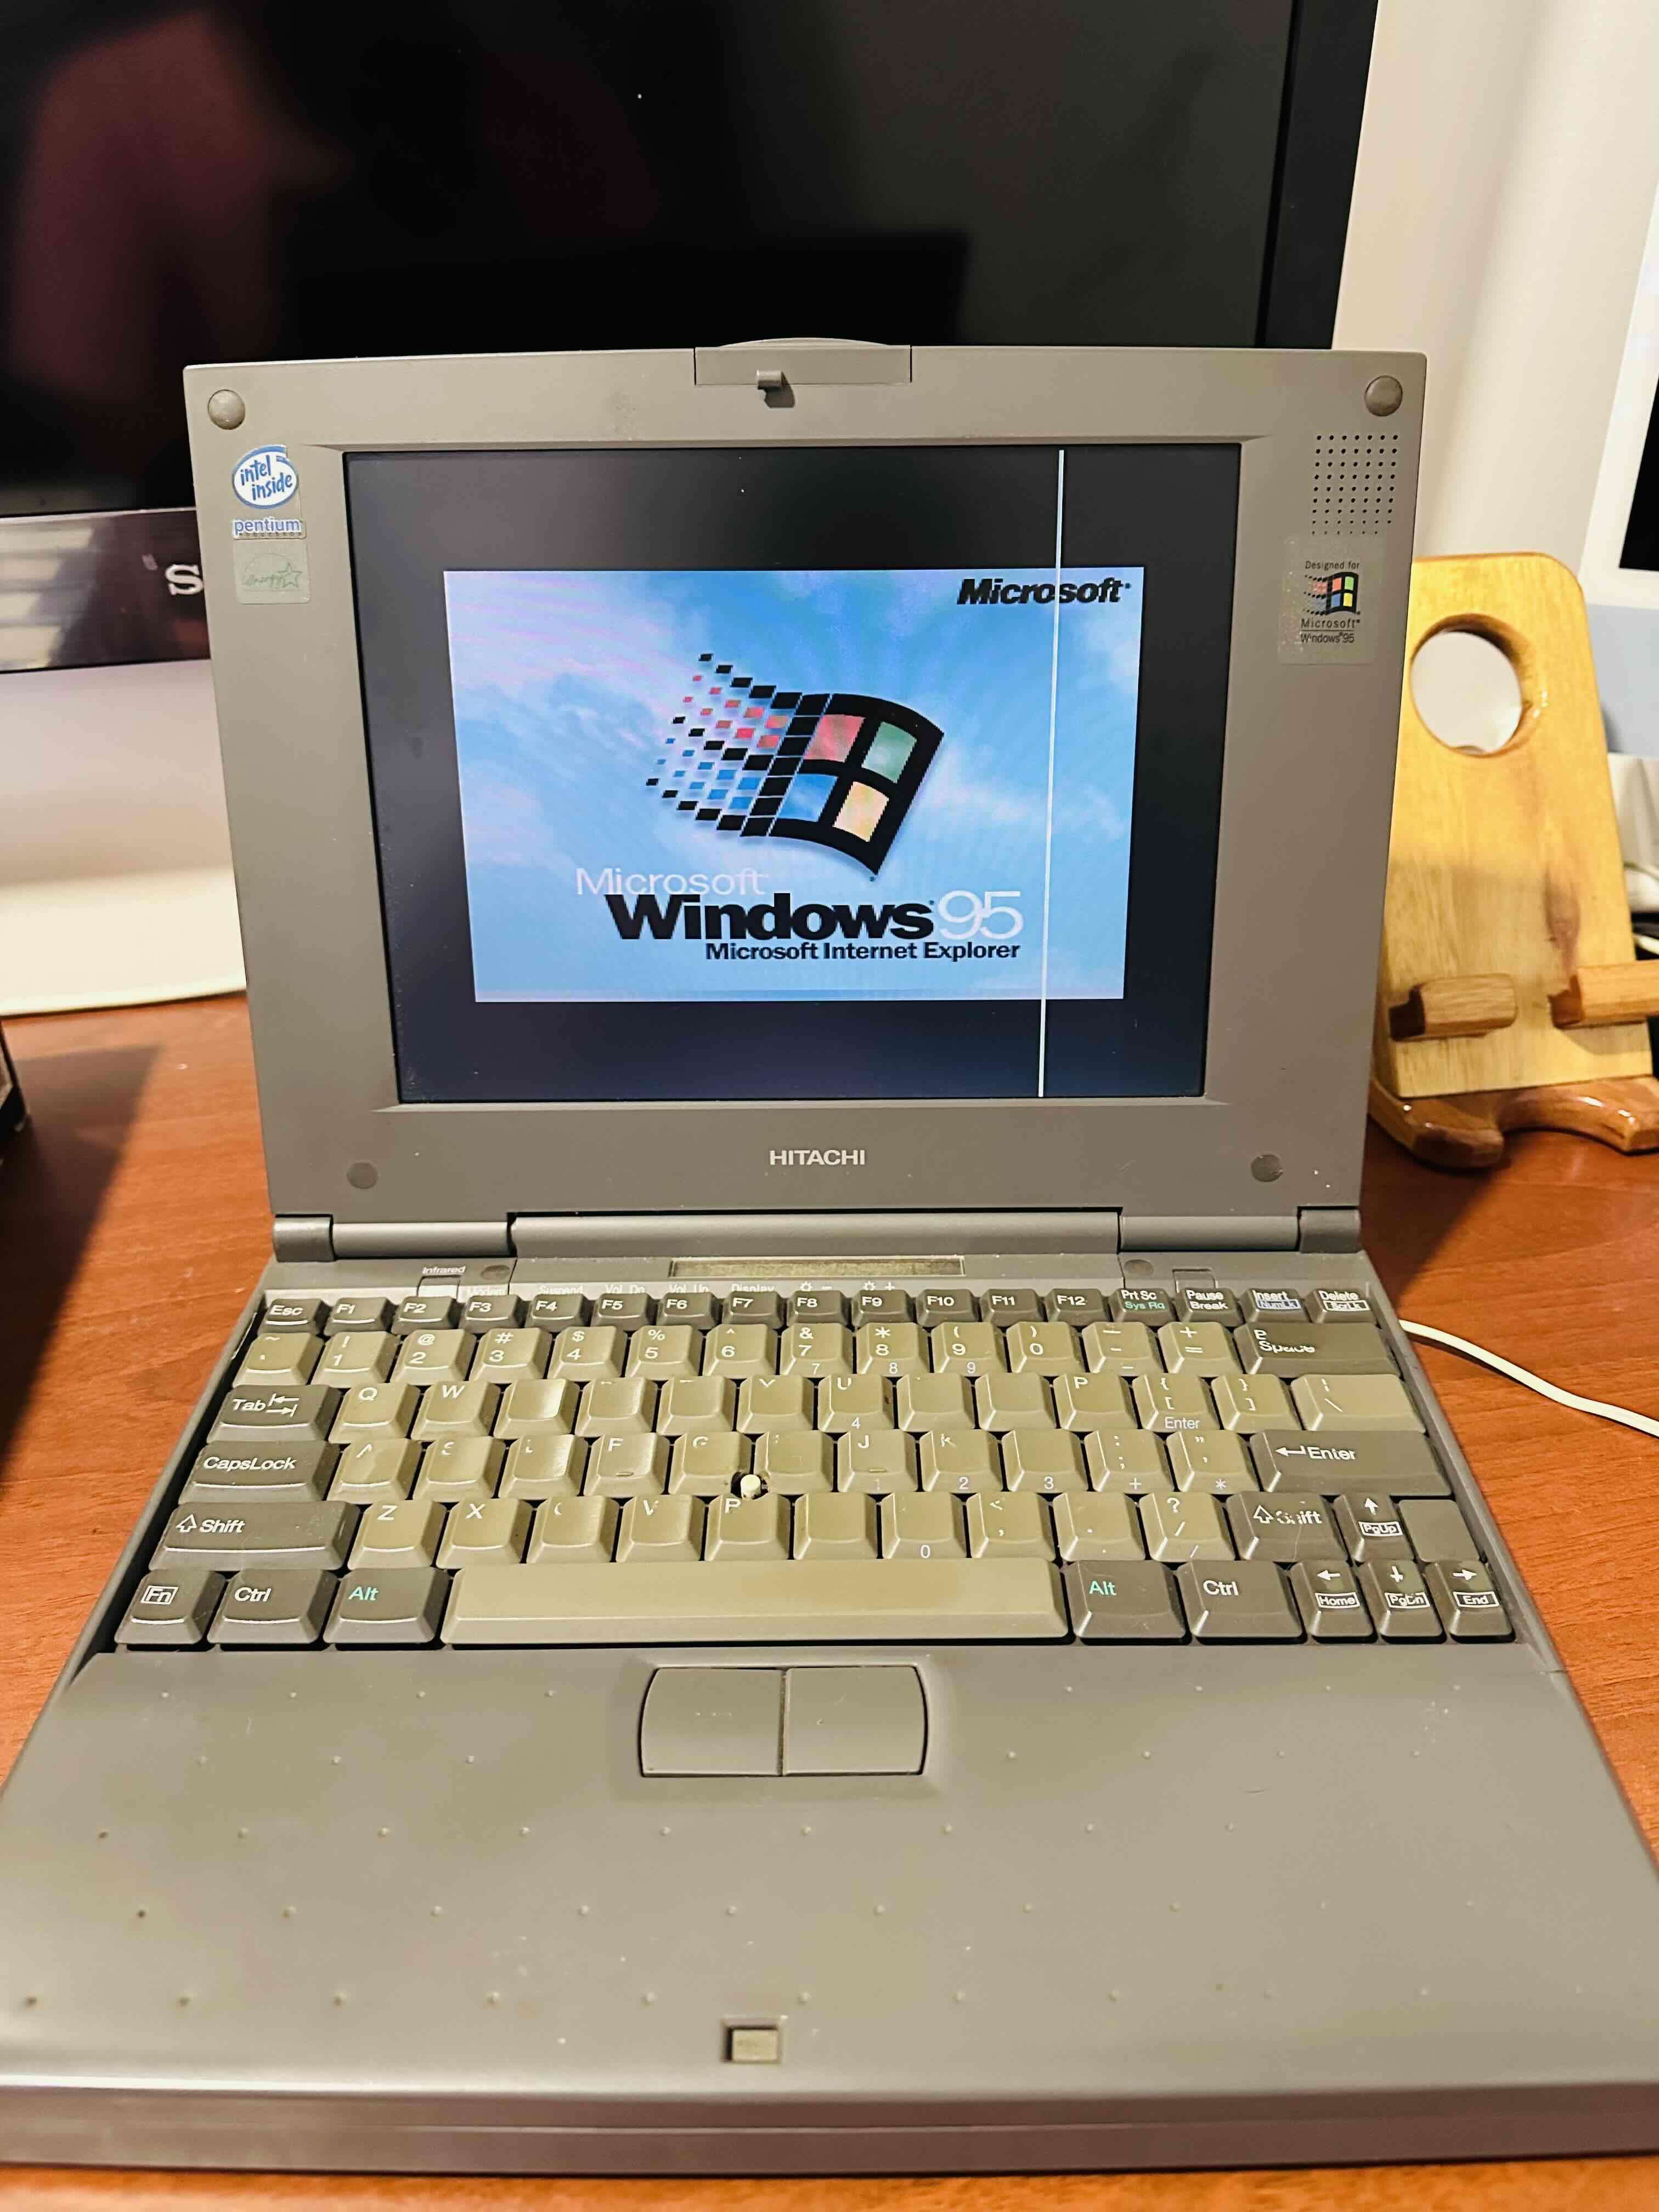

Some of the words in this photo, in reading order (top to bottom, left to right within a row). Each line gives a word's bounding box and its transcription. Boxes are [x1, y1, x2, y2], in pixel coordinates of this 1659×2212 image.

[240, 455, 271, 486] intel
[252, 472, 292, 500] inside
[234, 517, 300, 535] pentium
[1305, 560, 1344, 571] Designed
[1348, 561, 1360, 569] for
[957, 577, 1123, 605] Microsoft
[575, 867, 769, 896] Microsoft
[603, 893, 934, 940] Windows
[939, 890, 1024, 940] 95
[706, 942, 819, 960] Microsoft
[824, 943, 917, 960] Internet
[923, 941, 1021, 962] Explorer
[770, 1150, 865, 1165] HITACHI
[422, 1266, 466, 1275] Infrared
[731, 1283, 775, 1292] Display
[927, 1295, 955, 1306] F10
[991, 1295, 1015, 1306] F11
[1057, 1295, 1086, 1306] F12
[1121, 1290, 1139, 1300] Prt
[1141, 1290, 1157, 1300] Sc
[1186, 1289, 1224, 1300] Pause
[1252, 1290, 1289, 1299] Insert
[1318, 1290, 1358, 1301] Delete
[470, 1302, 492, 1312] F3
[535, 1301, 557, 1311] F4
[601, 1299, 623, 1310] F5
[666, 1299, 687, 1310] F6
[732, 1297, 753, 1308] F7
[797, 1297, 817, 1307] F8
[862, 1296, 883, 1307] F9
[1125, 1301, 1146, 1310] Sys
[1190, 1301, 1228, 1310] Break
[269, 1305, 303, 1316] Esc
[336, 1304, 356, 1314] F1
[404, 1303, 426, 1313] F2
[567, 1348, 582, 1360] 4
[645, 1347, 659, 1359] 5
[721, 1345, 736, 1357] 6
[798, 1345, 812, 1357] 7
[875, 1344, 890, 1356] 8
[952, 1343, 966, 1355] 9
[333, 1354, 343, 1366] 1
[409, 1351, 426, 1364] 2
[489, 1350, 505, 1362] 3
[811, 1363, 821, 1374] 7
[889, 1362, 898, 1374] 8
[967, 1362, 976, 1373] 9
[837, 1377, 852, 1390] U
[1074, 1376, 1088, 1389] P
[358, 1387, 378, 1401] Q
[441, 1385, 465, 1398] W
[233, 1398, 266, 1412] Tab
[851, 1417, 860, 1429] 4
[1164, 1417, 1200, 1429] Enter
[608, 1438, 624, 1452] F
[857, 1435, 870, 1448] J
[1307, 1446, 1356, 1461] Enter
[203, 1456, 299, 1471] CapsLock
[959, 1476, 969, 1489] 2
[1043, 1476, 1054, 1489] 3
[377, 1505, 398, 1521] Z
[465, 1503, 486, 1519] X
[199, 1519, 246, 1533] Shift
[1363, 1523, 1397, 1534] PgUp
[348, 1586, 379, 1601] Alt
[1088, 1580, 1117, 1596] Alt
[1203, 1580, 1239, 1596] Ctrl
[146, 1587, 172, 1602] Fn
[234, 1587, 272, 1602] Ctrl
[1318, 1595, 1356, 1605] Home
[1465, 1594, 1488, 1605] End
